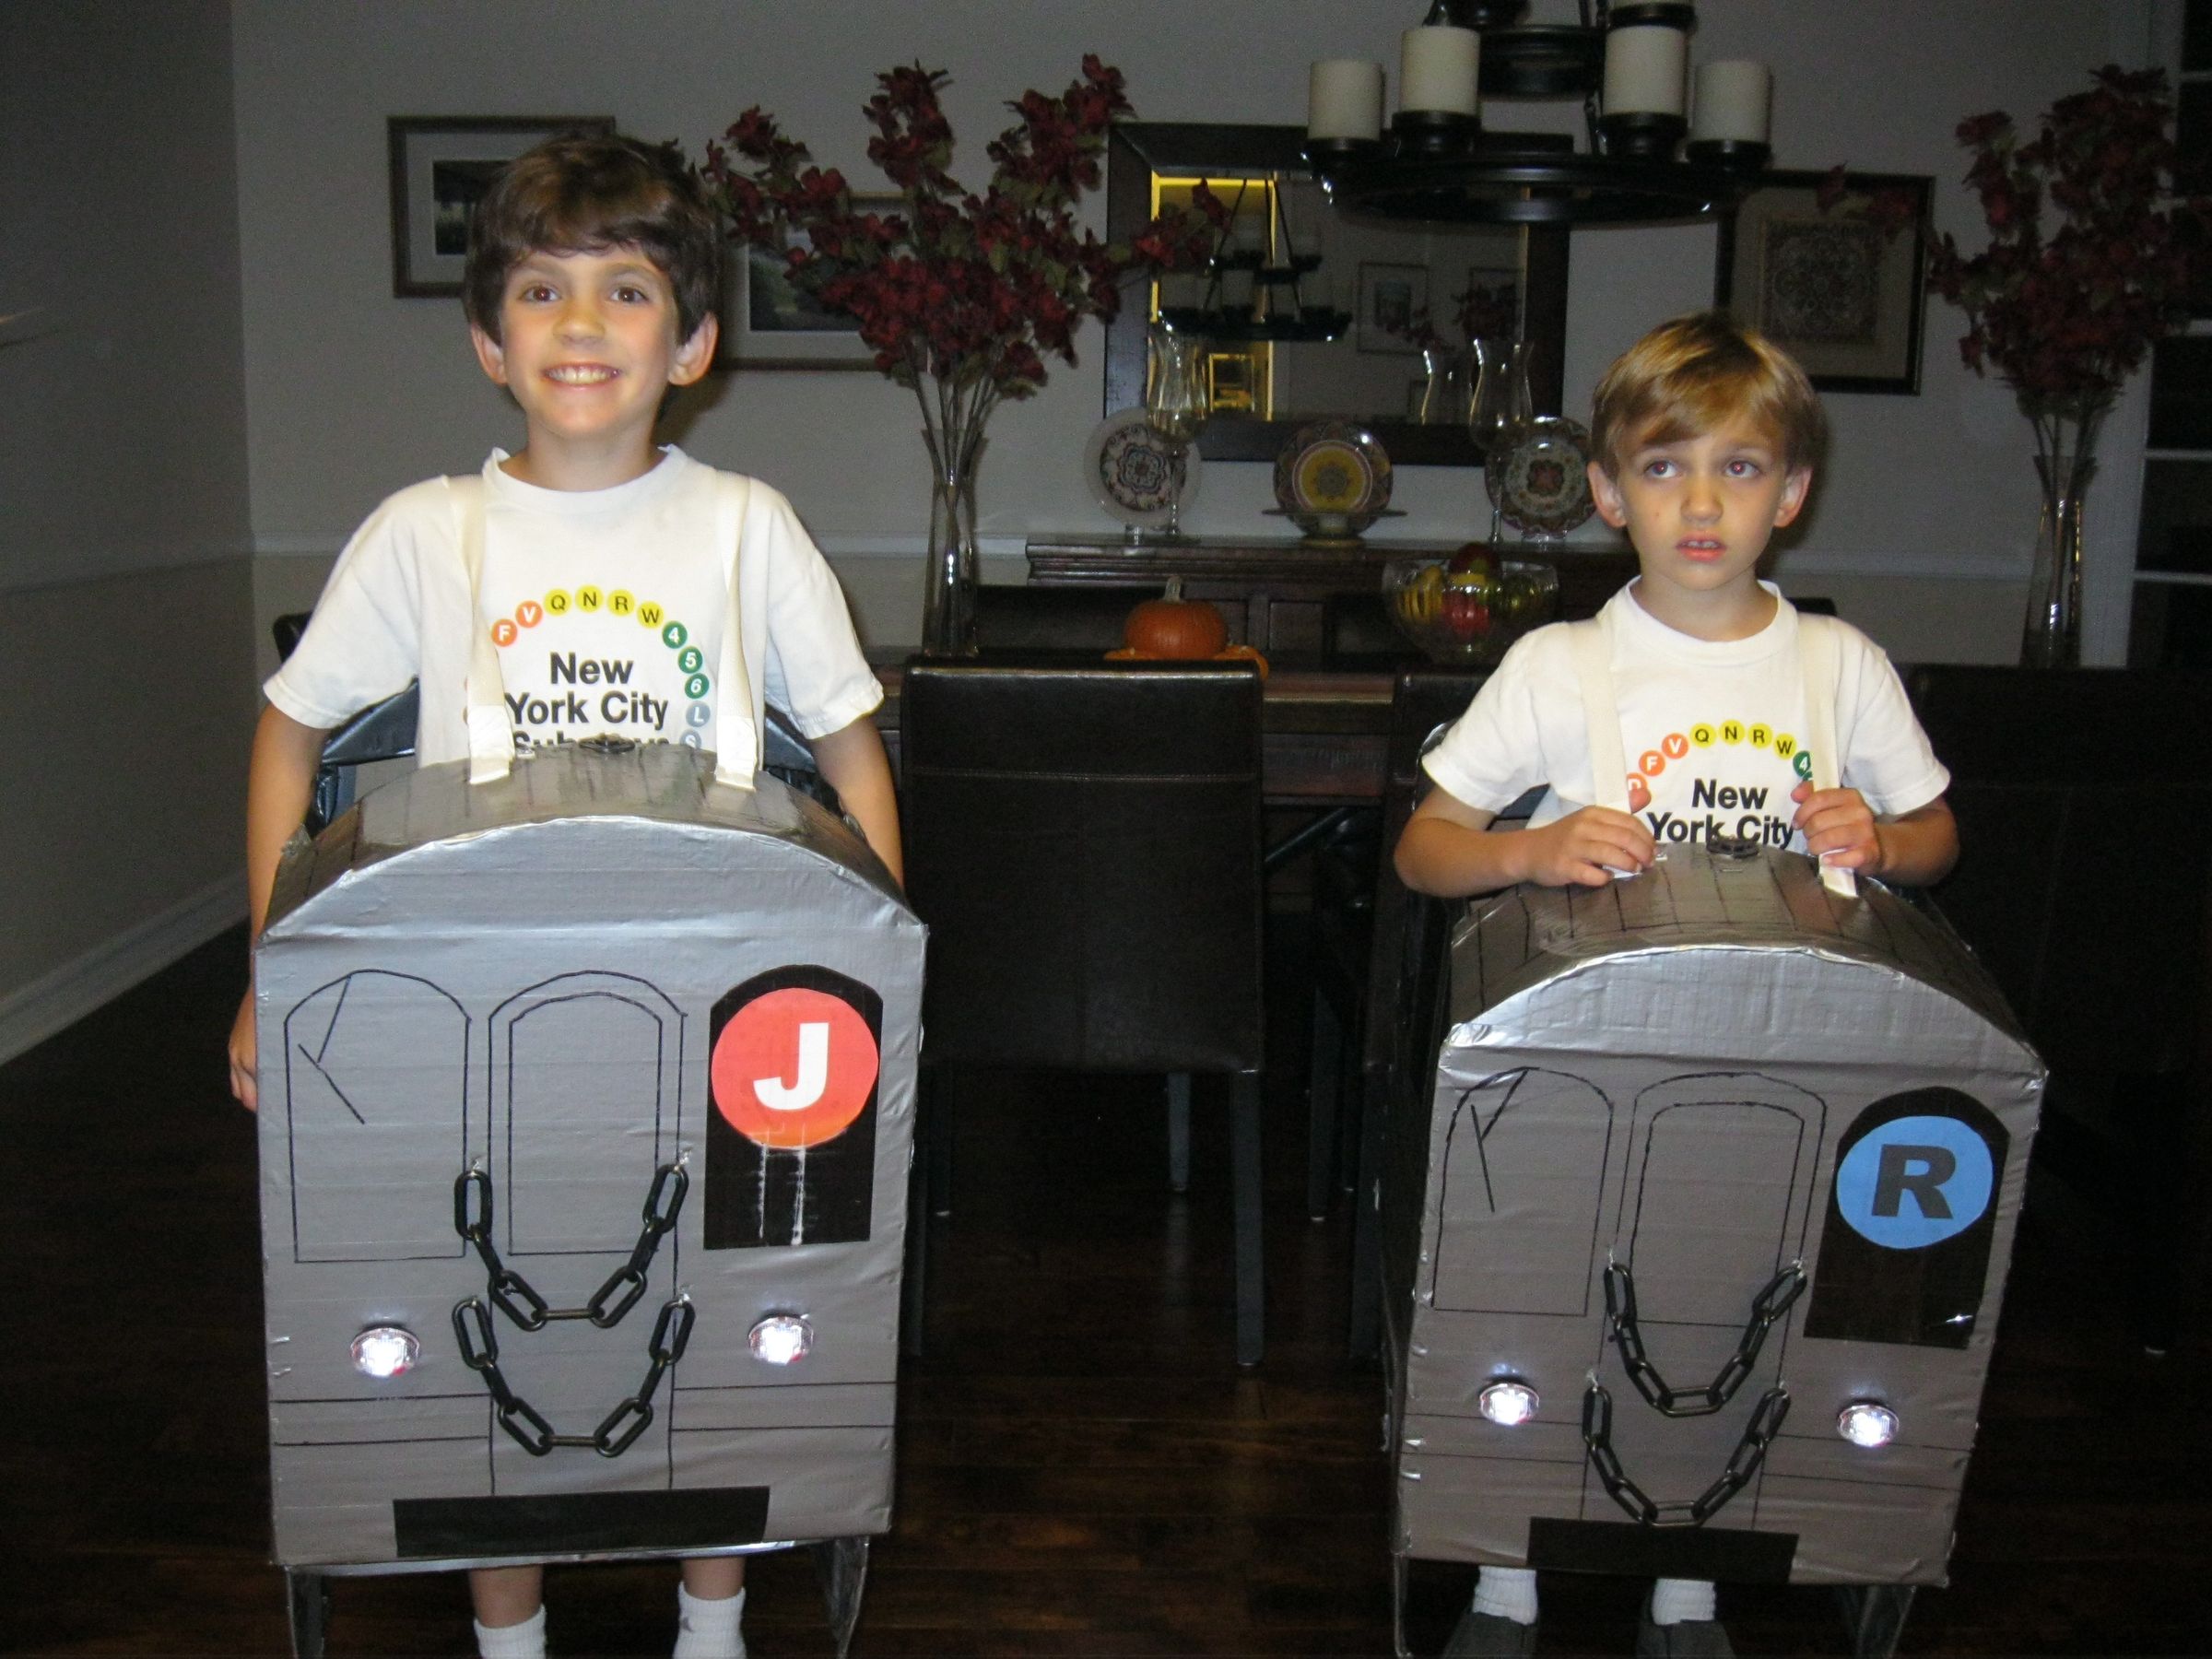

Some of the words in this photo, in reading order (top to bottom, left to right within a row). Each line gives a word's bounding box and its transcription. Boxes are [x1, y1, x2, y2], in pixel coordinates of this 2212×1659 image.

[550, 595, 566, 611] Q
[582, 592, 596, 606] N
[615, 596, 628, 610] R
[523, 606, 535, 621] V
[641, 609, 659, 624] W
[499, 625, 511, 641] F
[669, 628, 680, 643] 4
[686, 653, 697, 667] 5
[550, 652, 633, 685] New
[691, 679, 701, 693] 6
[504, 691, 589, 724] York
[601, 690, 668, 730] City
[694, 706, 704, 723] L
[1646, 756, 1658, 771] F
[1669, 738, 1682, 753] V
[1695, 729, 1709, 743] Q
[1725, 726, 1737, 740] N
[1753, 729, 1765, 744] R
[1777, 740, 1793, 755] W
[1799, 756, 1808, 771] 4
[1691, 778, 1768, 810] New
[1647, 811, 1725, 843] York
[1736, 815, 1794, 851] City
[753, 1022, 829, 1111] J
[1872, 1144, 1956, 1219] R
